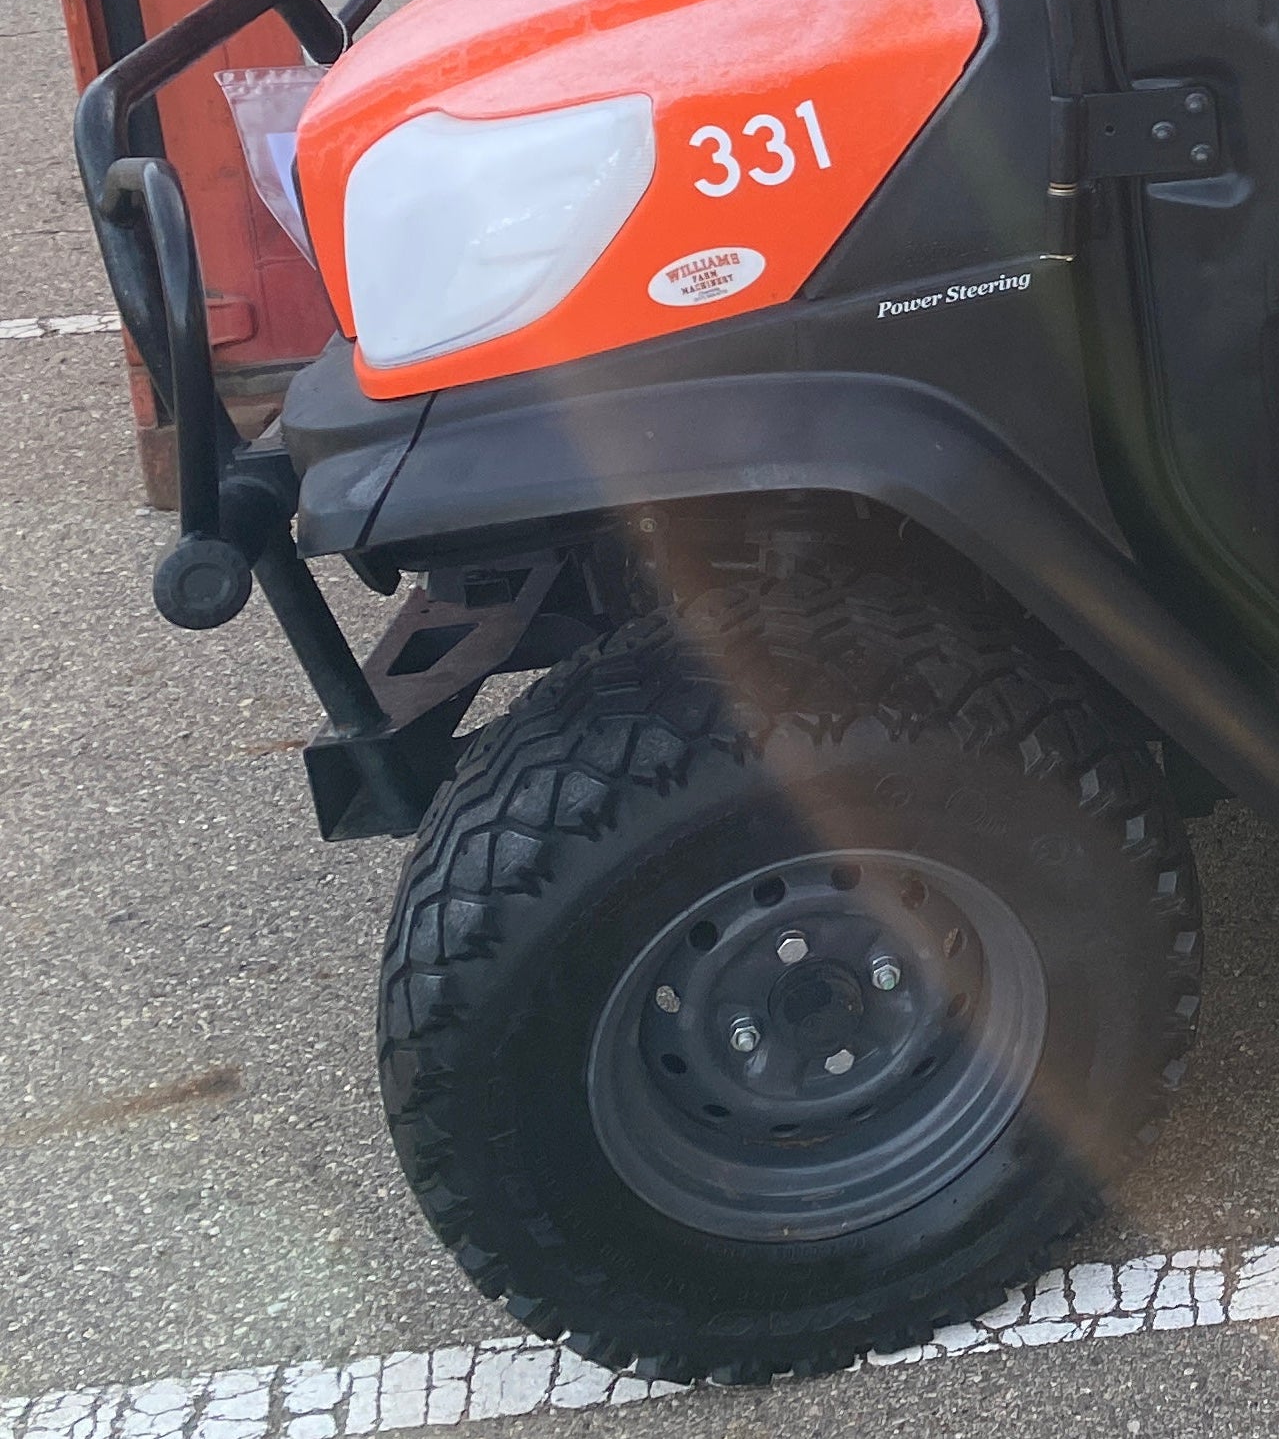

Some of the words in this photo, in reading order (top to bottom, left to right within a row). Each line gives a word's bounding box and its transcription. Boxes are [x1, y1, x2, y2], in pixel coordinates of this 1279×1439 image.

[689, 98, 832, 198] 331
[666, 252, 741, 284] WILLIAMS
[692, 269, 718, 283] FARM
[681, 274, 735, 296] MACHINERY
[877, 293, 943, 319] Power
[945, 273, 1032, 304] Steering
